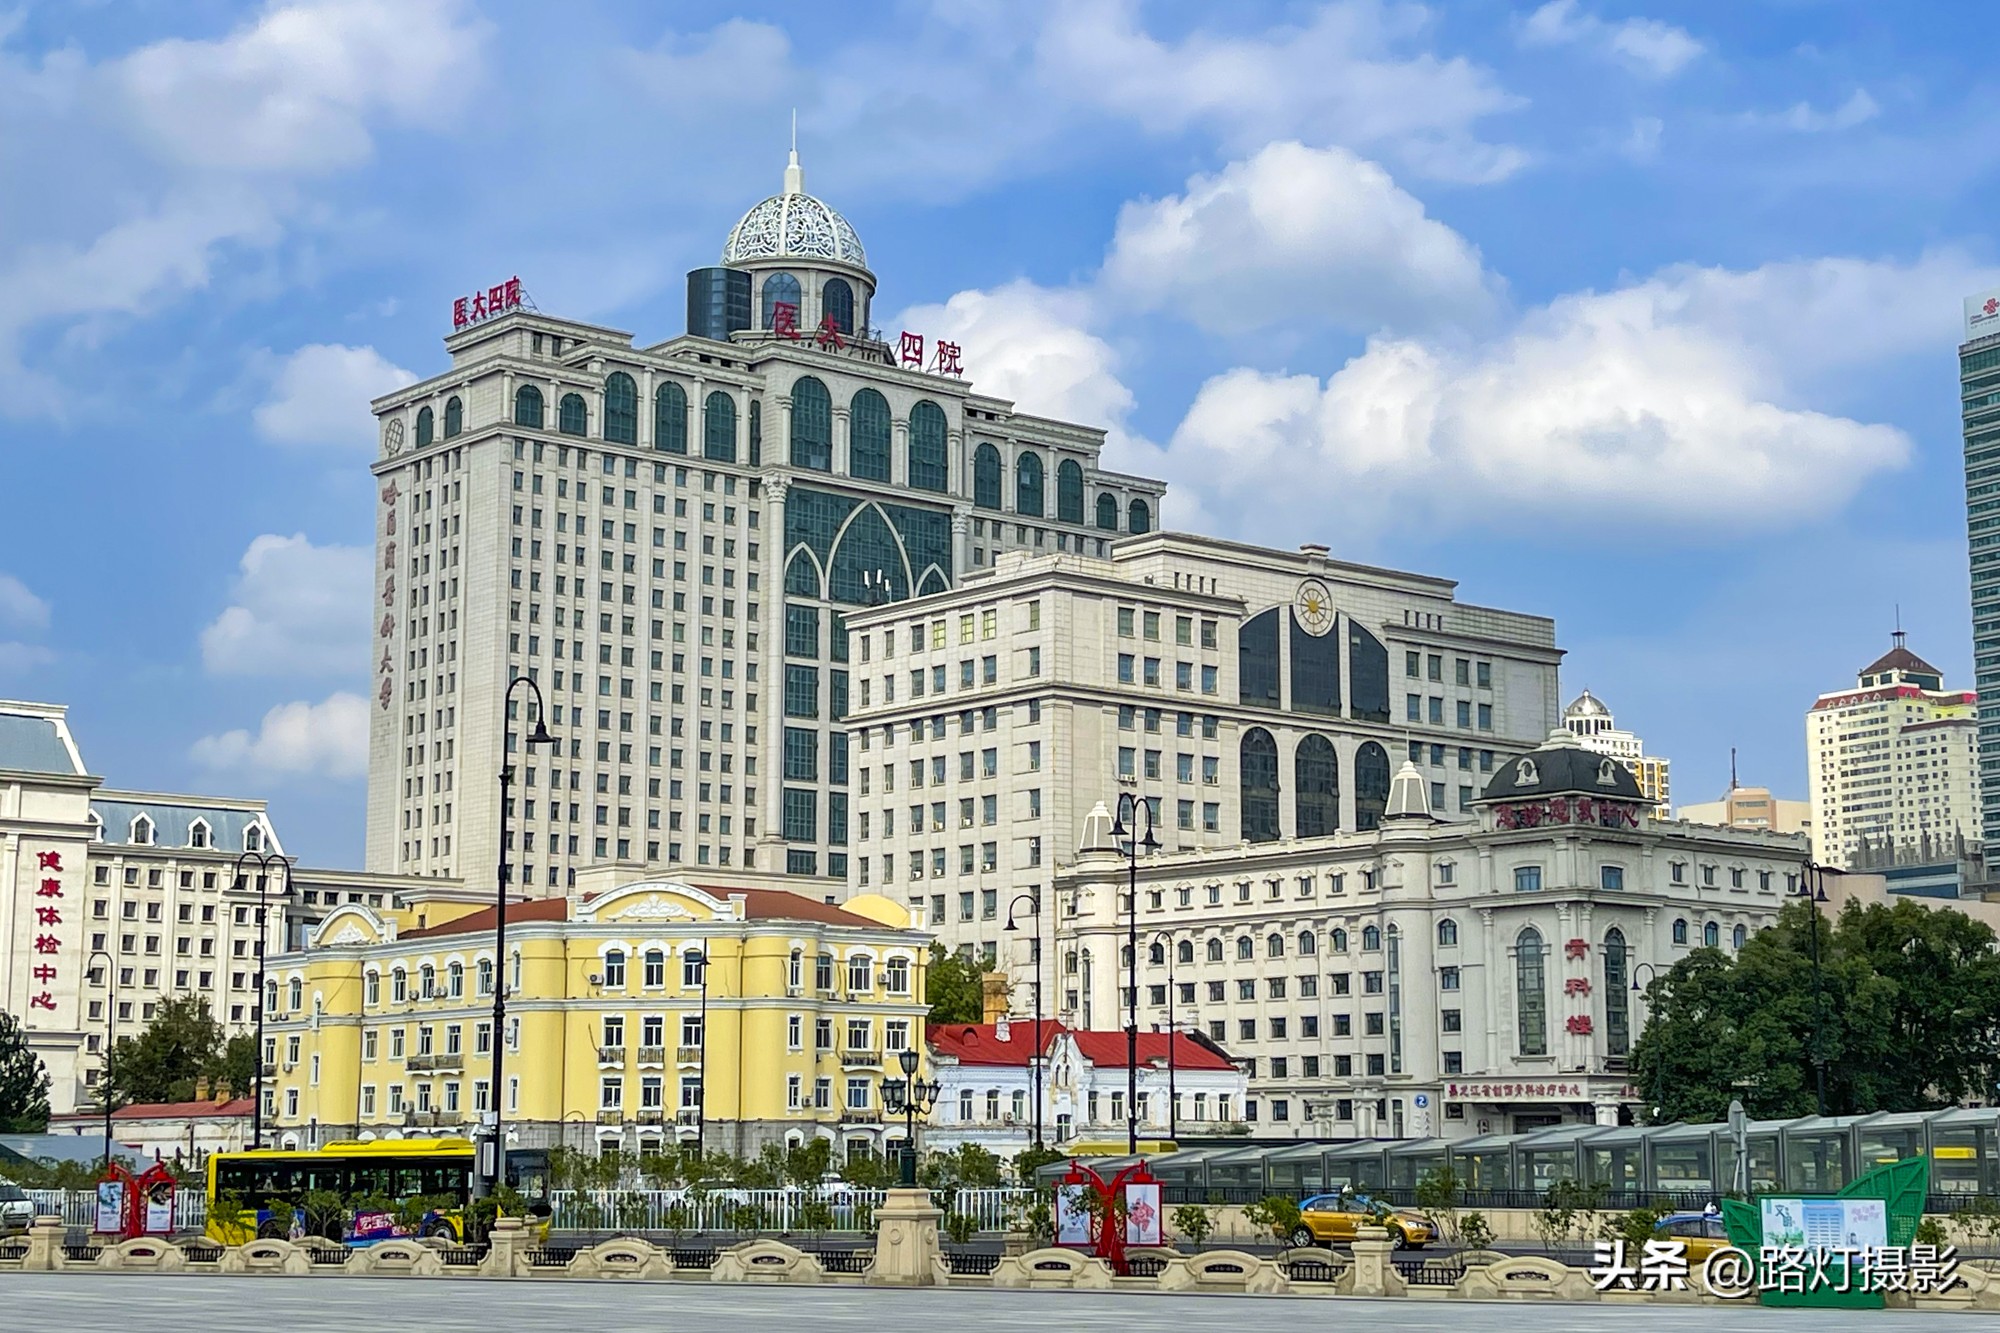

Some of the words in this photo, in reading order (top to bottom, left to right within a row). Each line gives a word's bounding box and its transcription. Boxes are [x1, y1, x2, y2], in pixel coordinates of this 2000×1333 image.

[453, 275, 521, 327] 医大四院
[774, 301, 964, 375] 医大四院
[30, 850, 64, 1011] 健康体检中心
[1563, 938, 1594, 1035] 骨科楼
